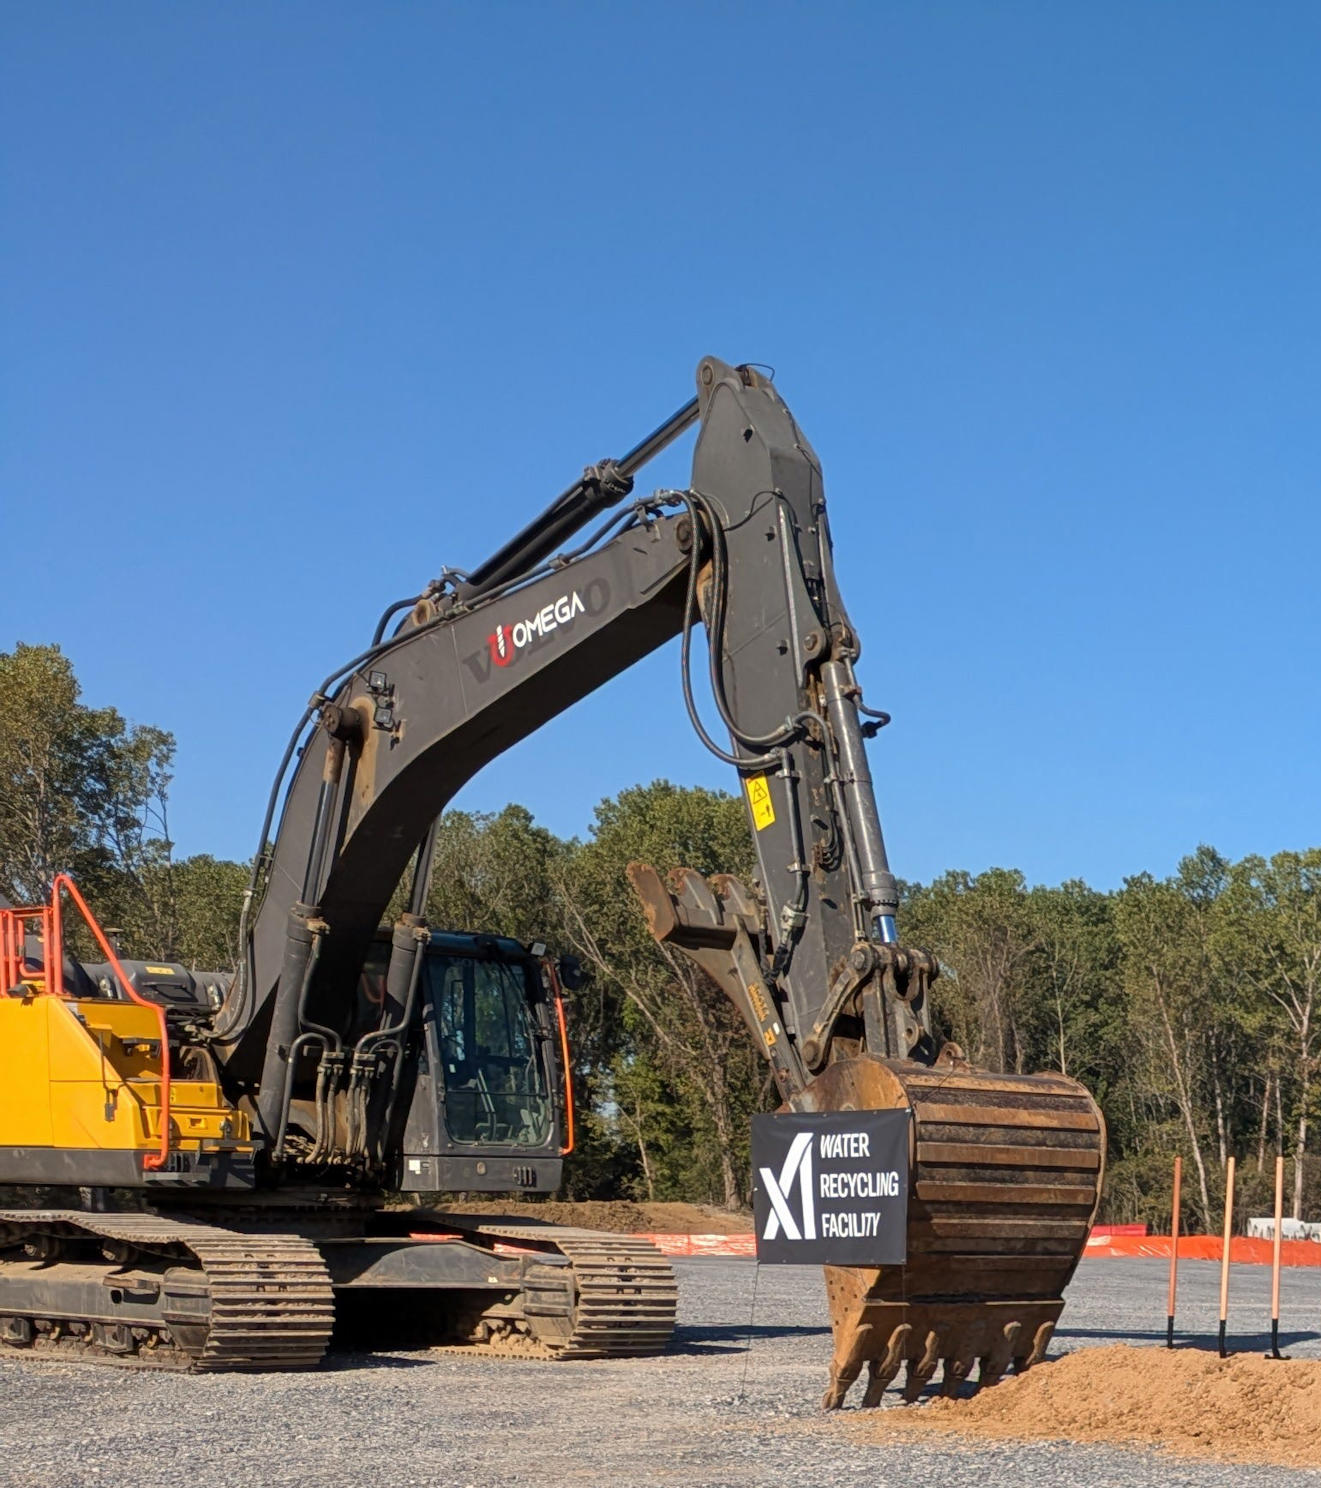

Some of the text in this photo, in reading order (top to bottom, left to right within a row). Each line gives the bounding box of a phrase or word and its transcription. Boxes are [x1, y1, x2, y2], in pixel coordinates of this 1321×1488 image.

[511, 591, 586, 648] OMEGA
[820, 1132, 870, 1158] WATER
[820, 1171, 899, 1198] RECYCLING
[821, 1212, 881, 1238] FACILITY
